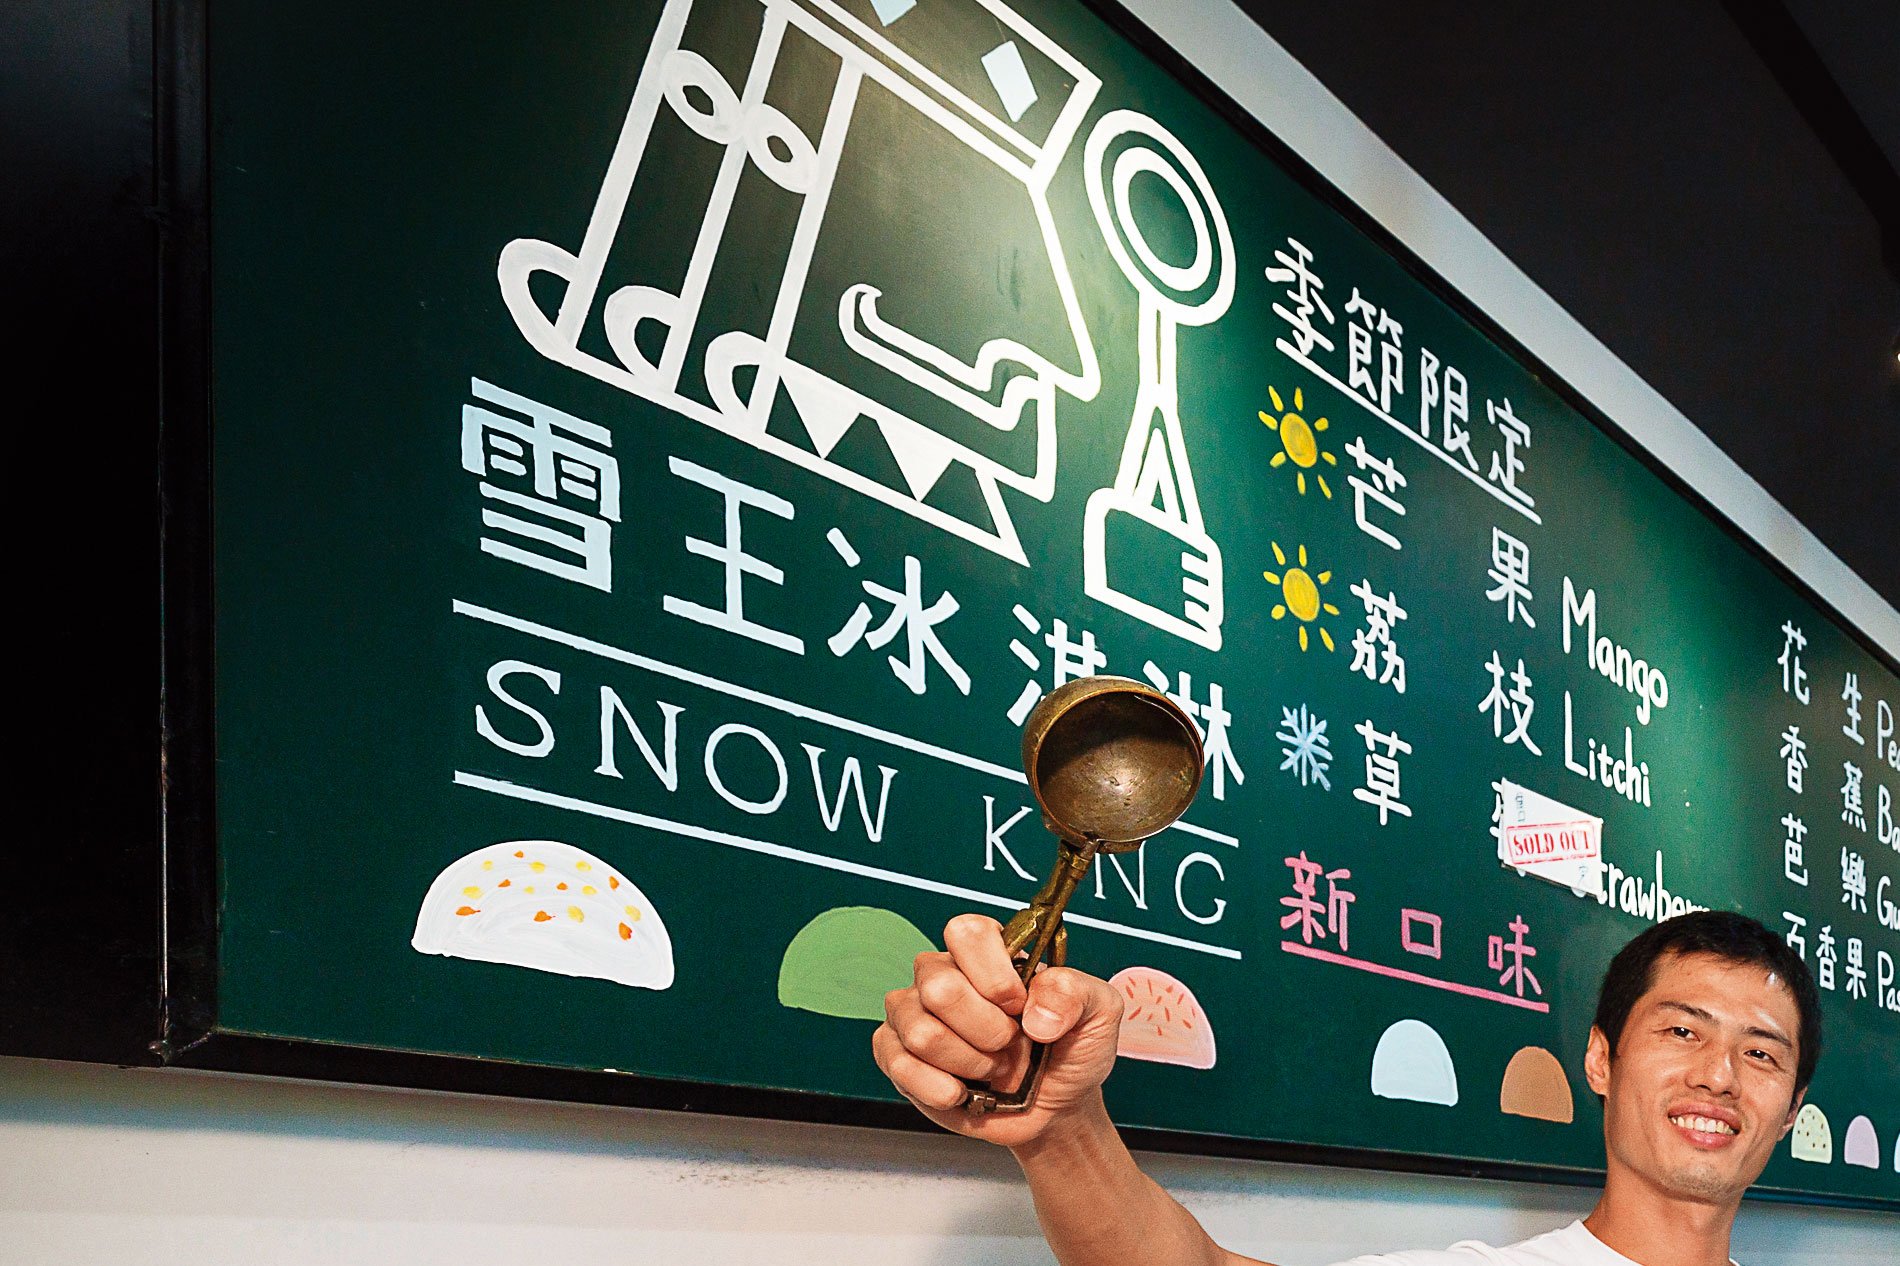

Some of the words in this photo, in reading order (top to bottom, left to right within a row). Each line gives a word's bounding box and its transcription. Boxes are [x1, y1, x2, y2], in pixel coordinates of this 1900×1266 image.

[1265, 238, 1536, 509] 季節限定
[1563, 576, 1669, 725] Mango
[474, 660, 899, 843] SNOW
[984, 795, 1227, 926] KNG
[1564, 690, 1652, 807] Litchi
[1513, 832, 1555, 857] SOLD
[1560, 830, 1590, 851] OUT
[1280, 850, 1544, 998] 新口味
